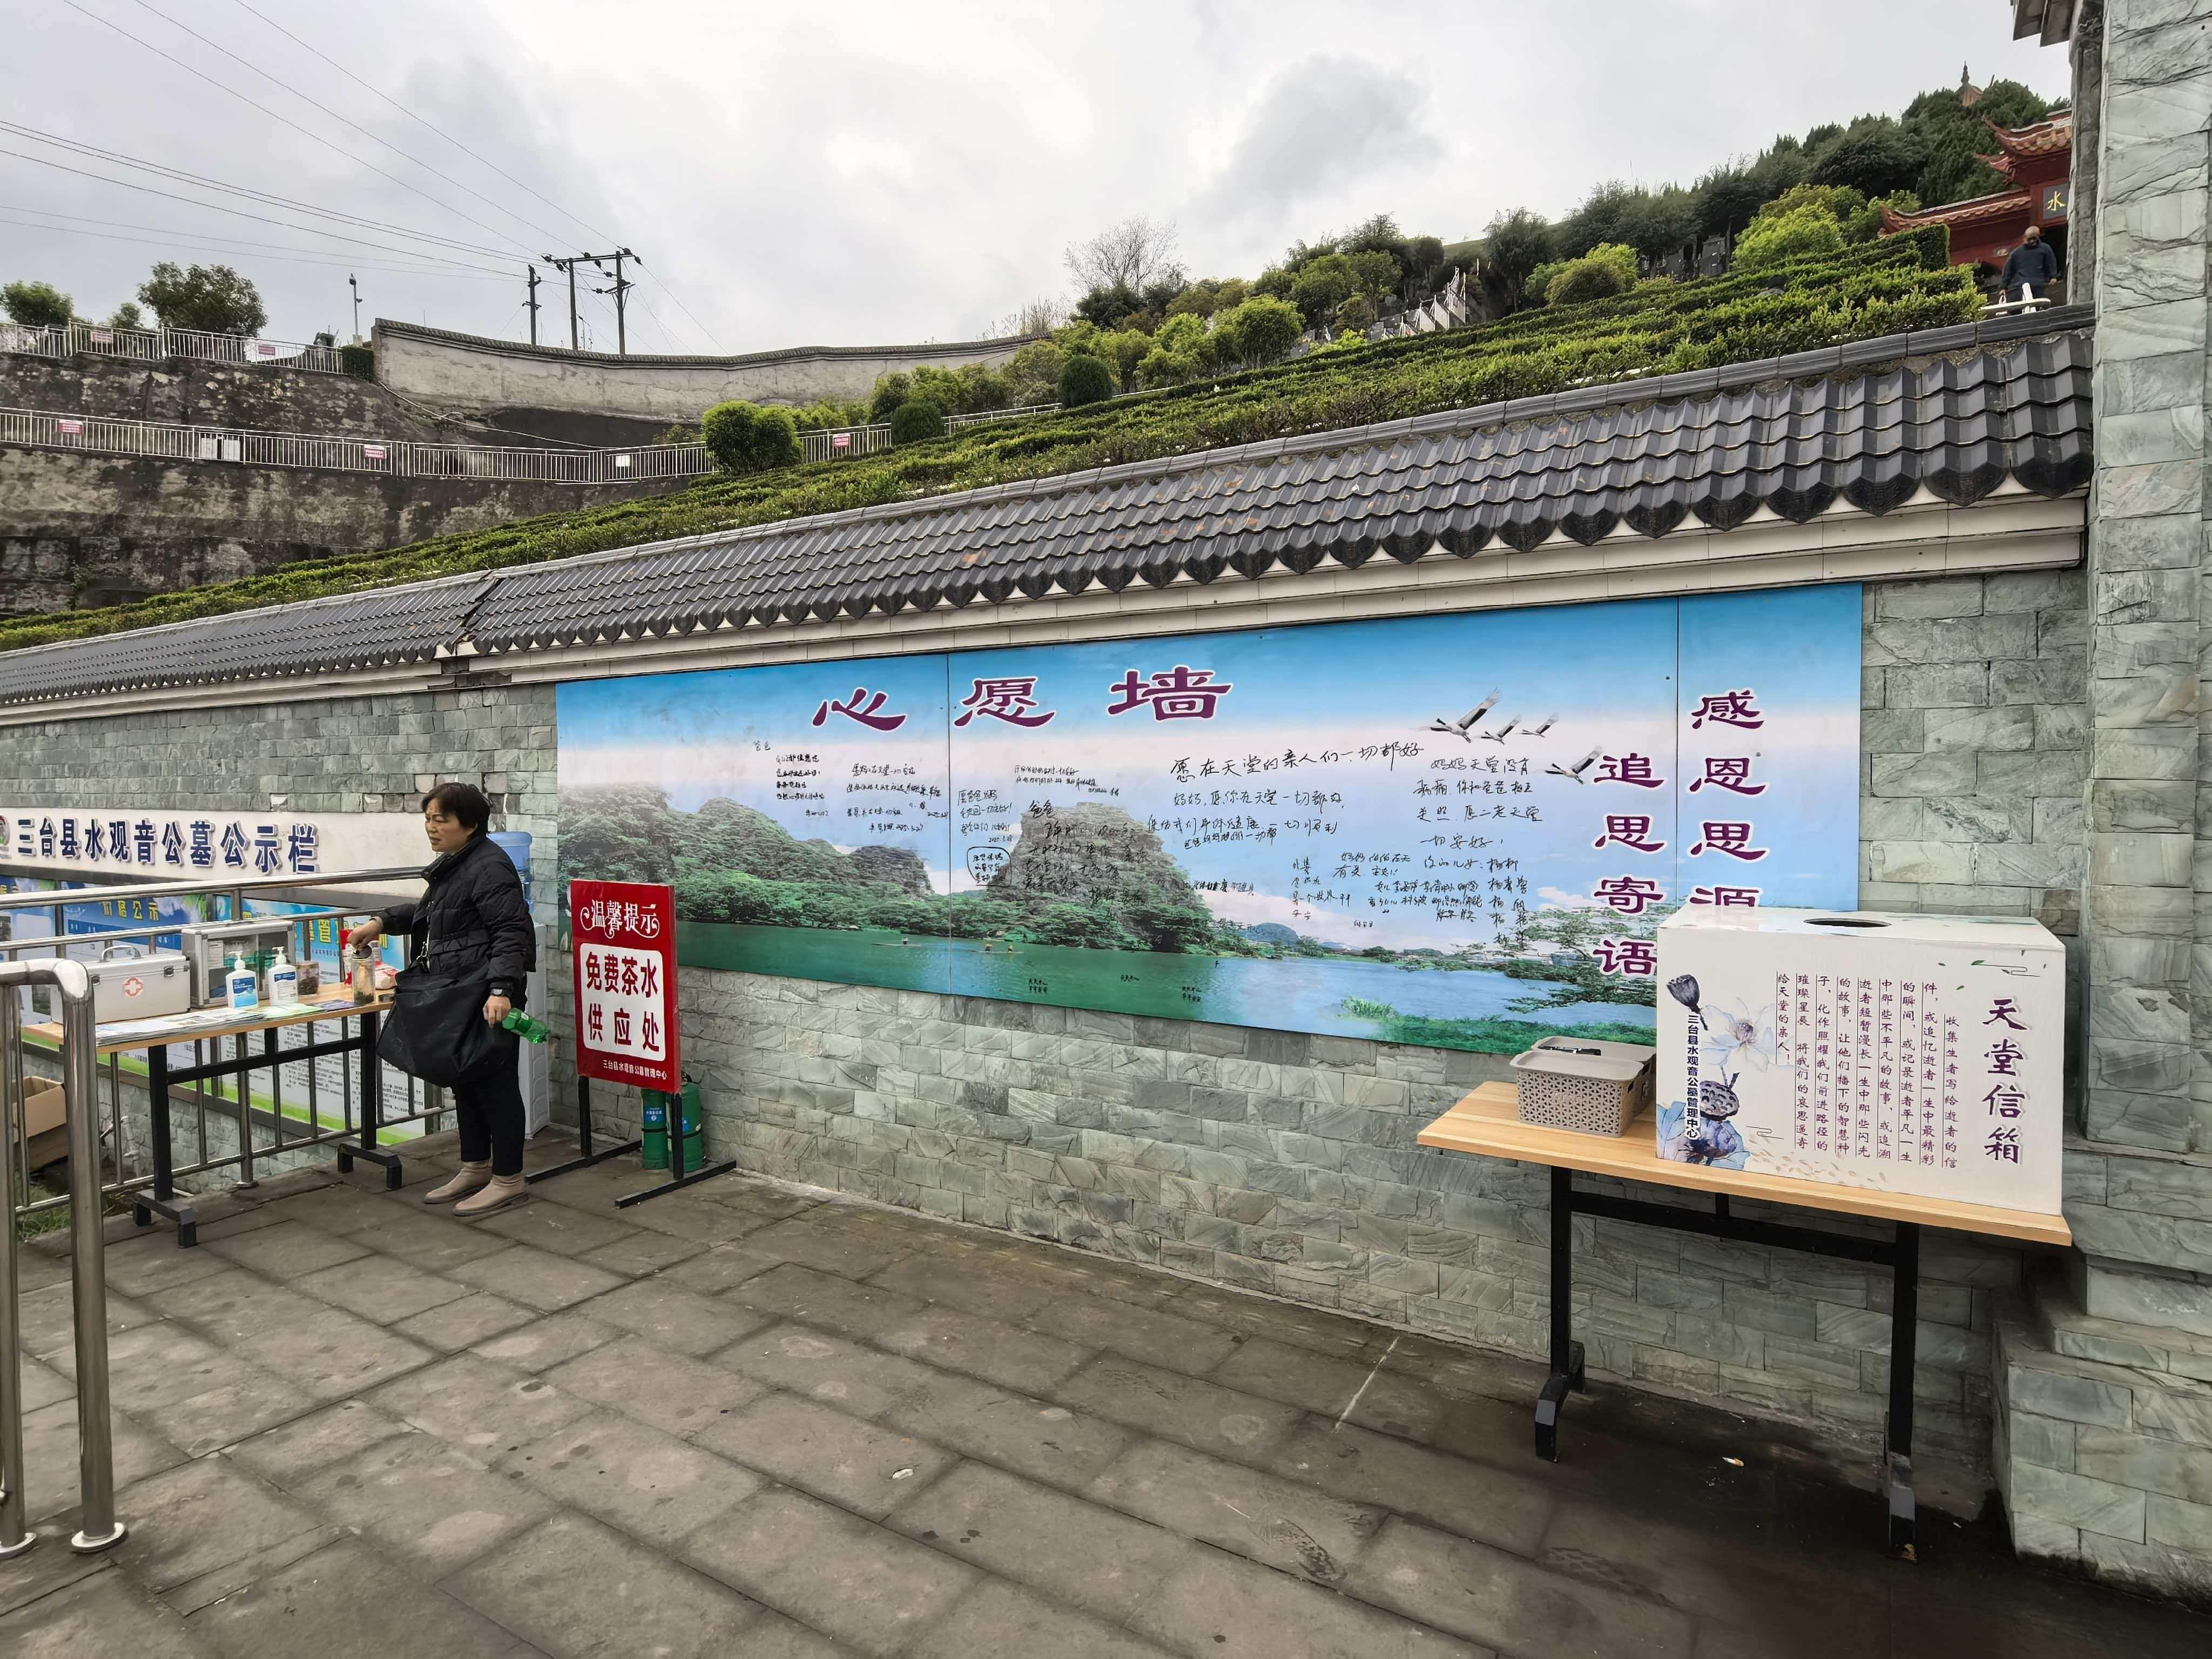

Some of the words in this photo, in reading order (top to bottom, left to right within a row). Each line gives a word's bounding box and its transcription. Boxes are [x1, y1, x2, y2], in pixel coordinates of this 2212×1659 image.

[2047, 191, 2066, 211] 水
[812, 666, 1233, 731] 心愿墙
[17, 816, 320, 874] 三台县水观音公墓公示栏
[1592, 753, 1664, 975] 追思寄语
[580, 899, 660, 939] 温馨提示
[585, 951, 658, 999] 免费茶水
[588, 1002, 660, 1053] 供应处
[1687, 1015, 1700, 1138] 三台县水观音公墓管理中心
[1944, 1016, 1960, 1168] 收集生者写给逝者的信
[1981, 999, 2028, 1164] 天堂信箱
